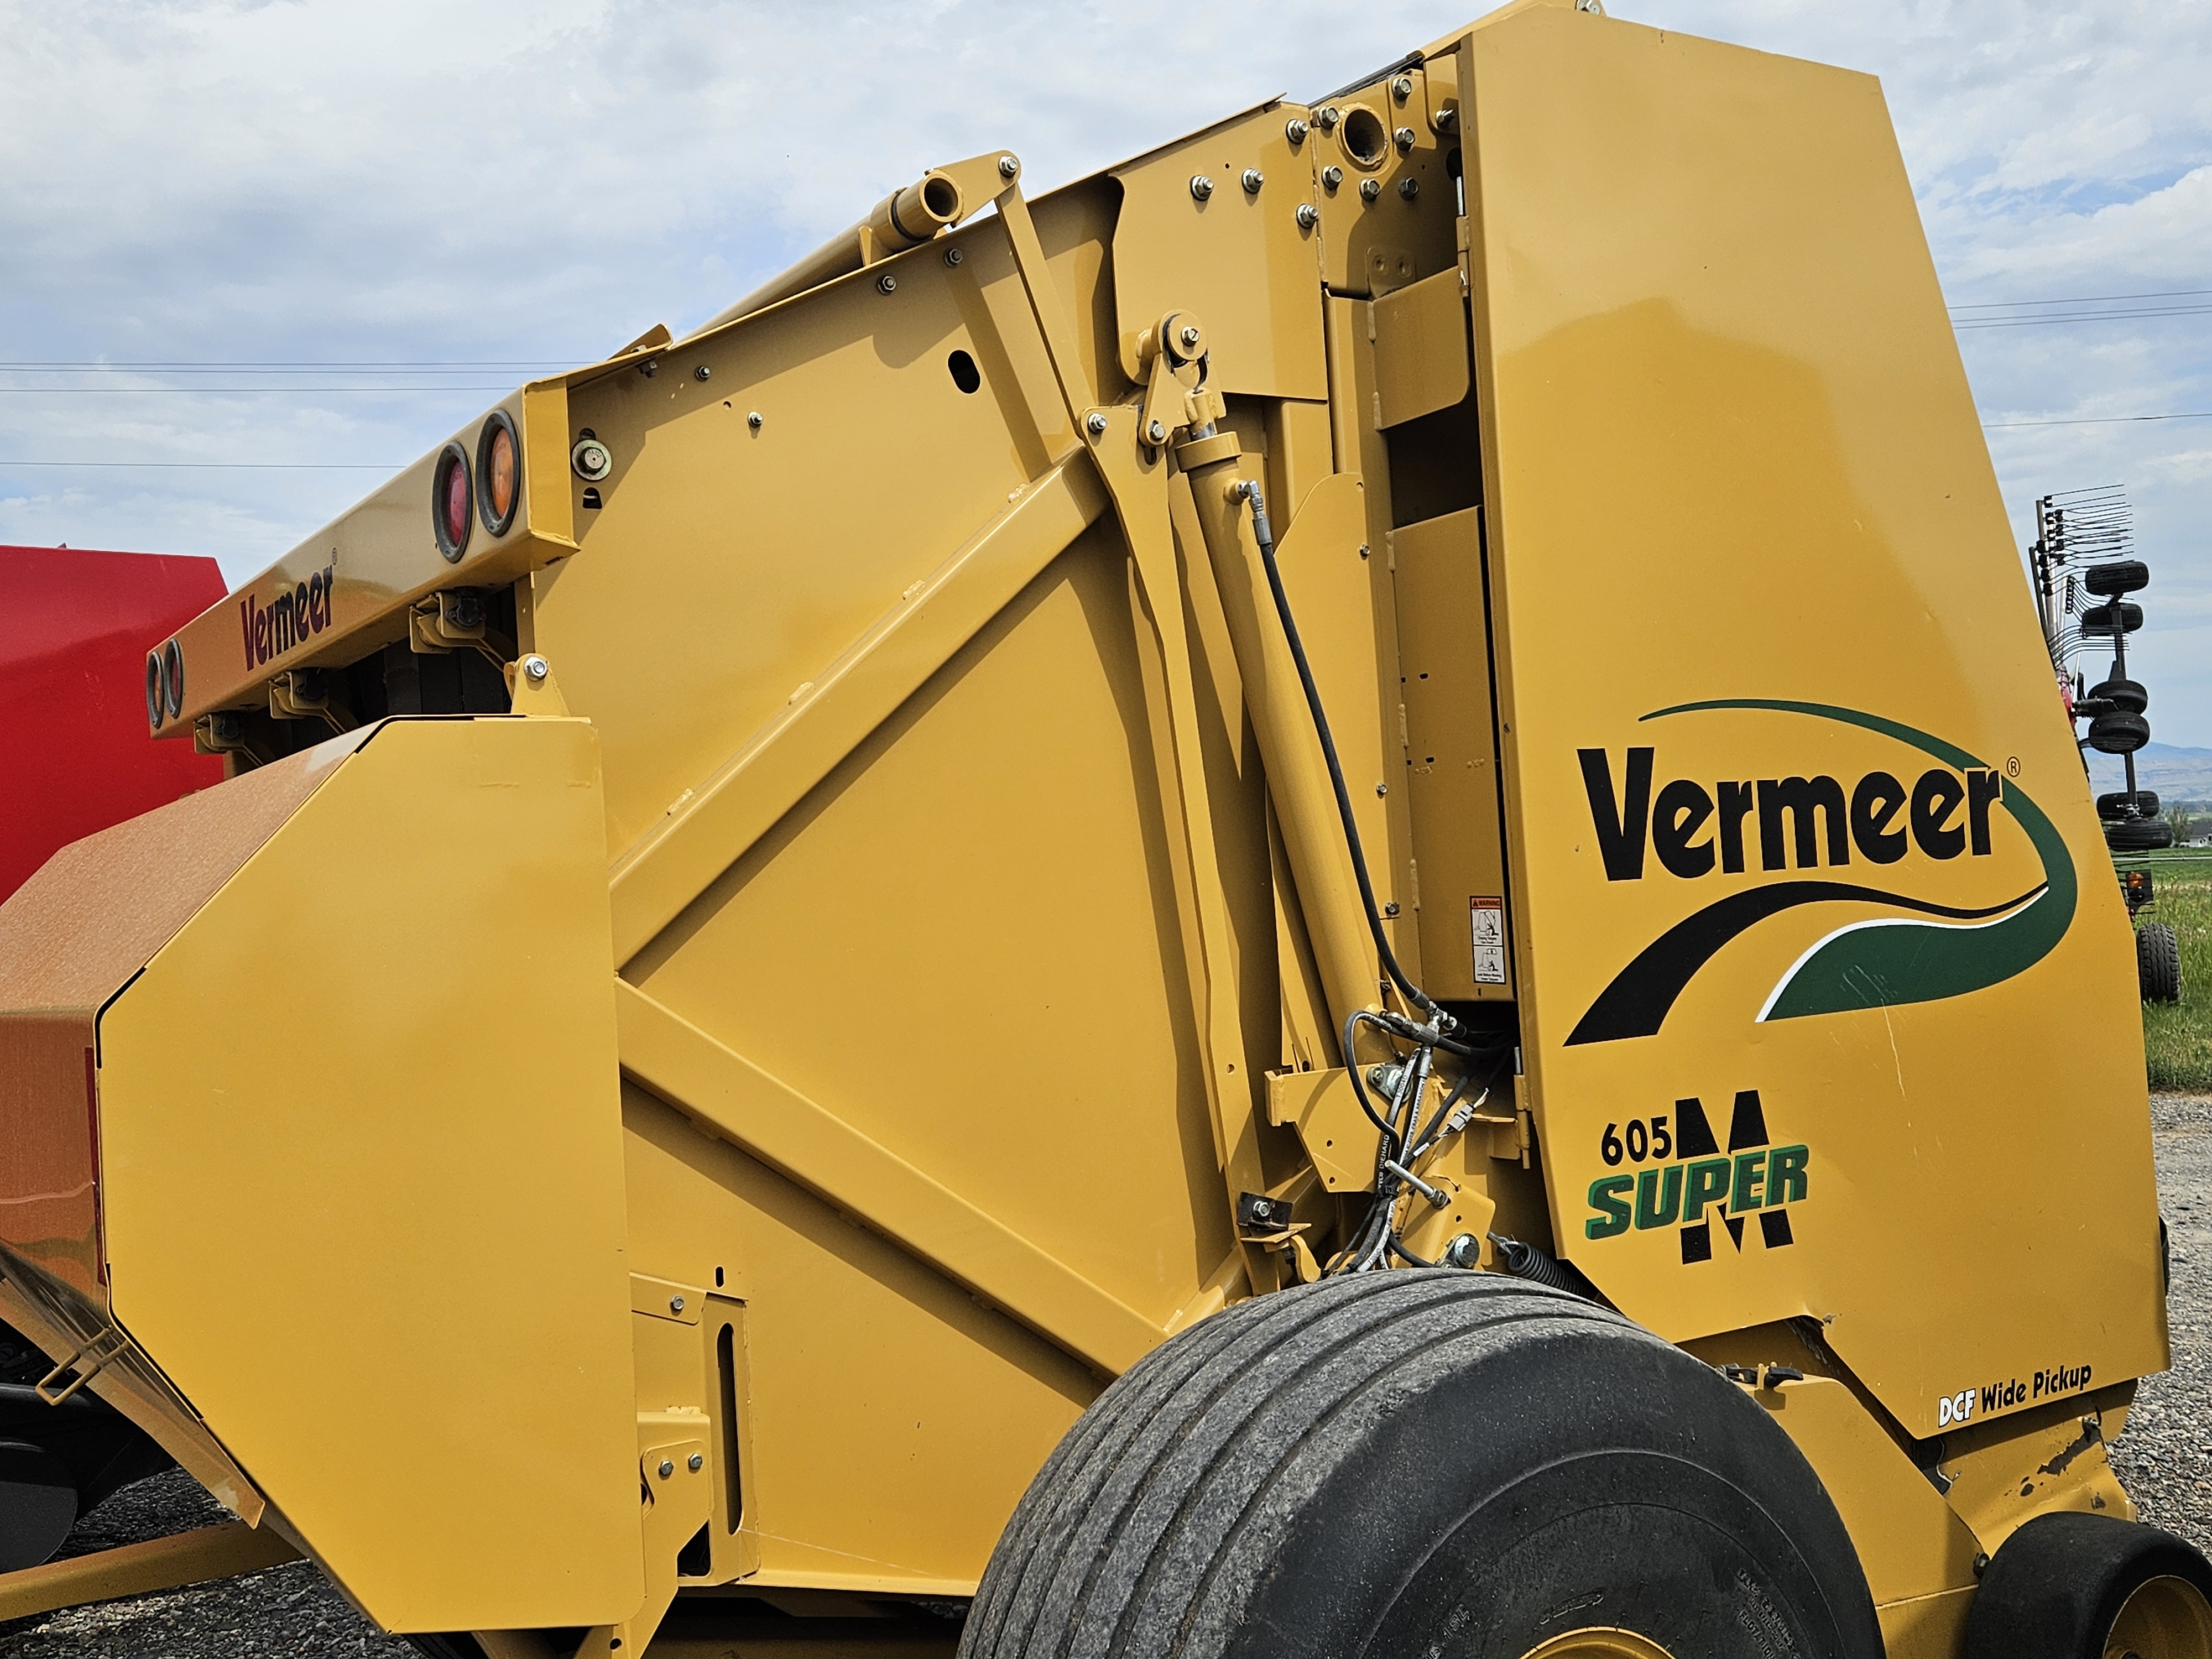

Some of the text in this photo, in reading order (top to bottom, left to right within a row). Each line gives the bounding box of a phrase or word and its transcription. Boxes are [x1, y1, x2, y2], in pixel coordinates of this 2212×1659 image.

[240, 564, 333, 672] Vermeer
[1576, 746, 2002, 882] Vermeer
[1379, 1134, 1390, 1169] DIEHARD
[1601, 1116, 1672, 1166] 605
[1585, 1144, 1809, 1240] SUPER
[1938, 1364, 2092, 1428] DCF Wide Pickup
